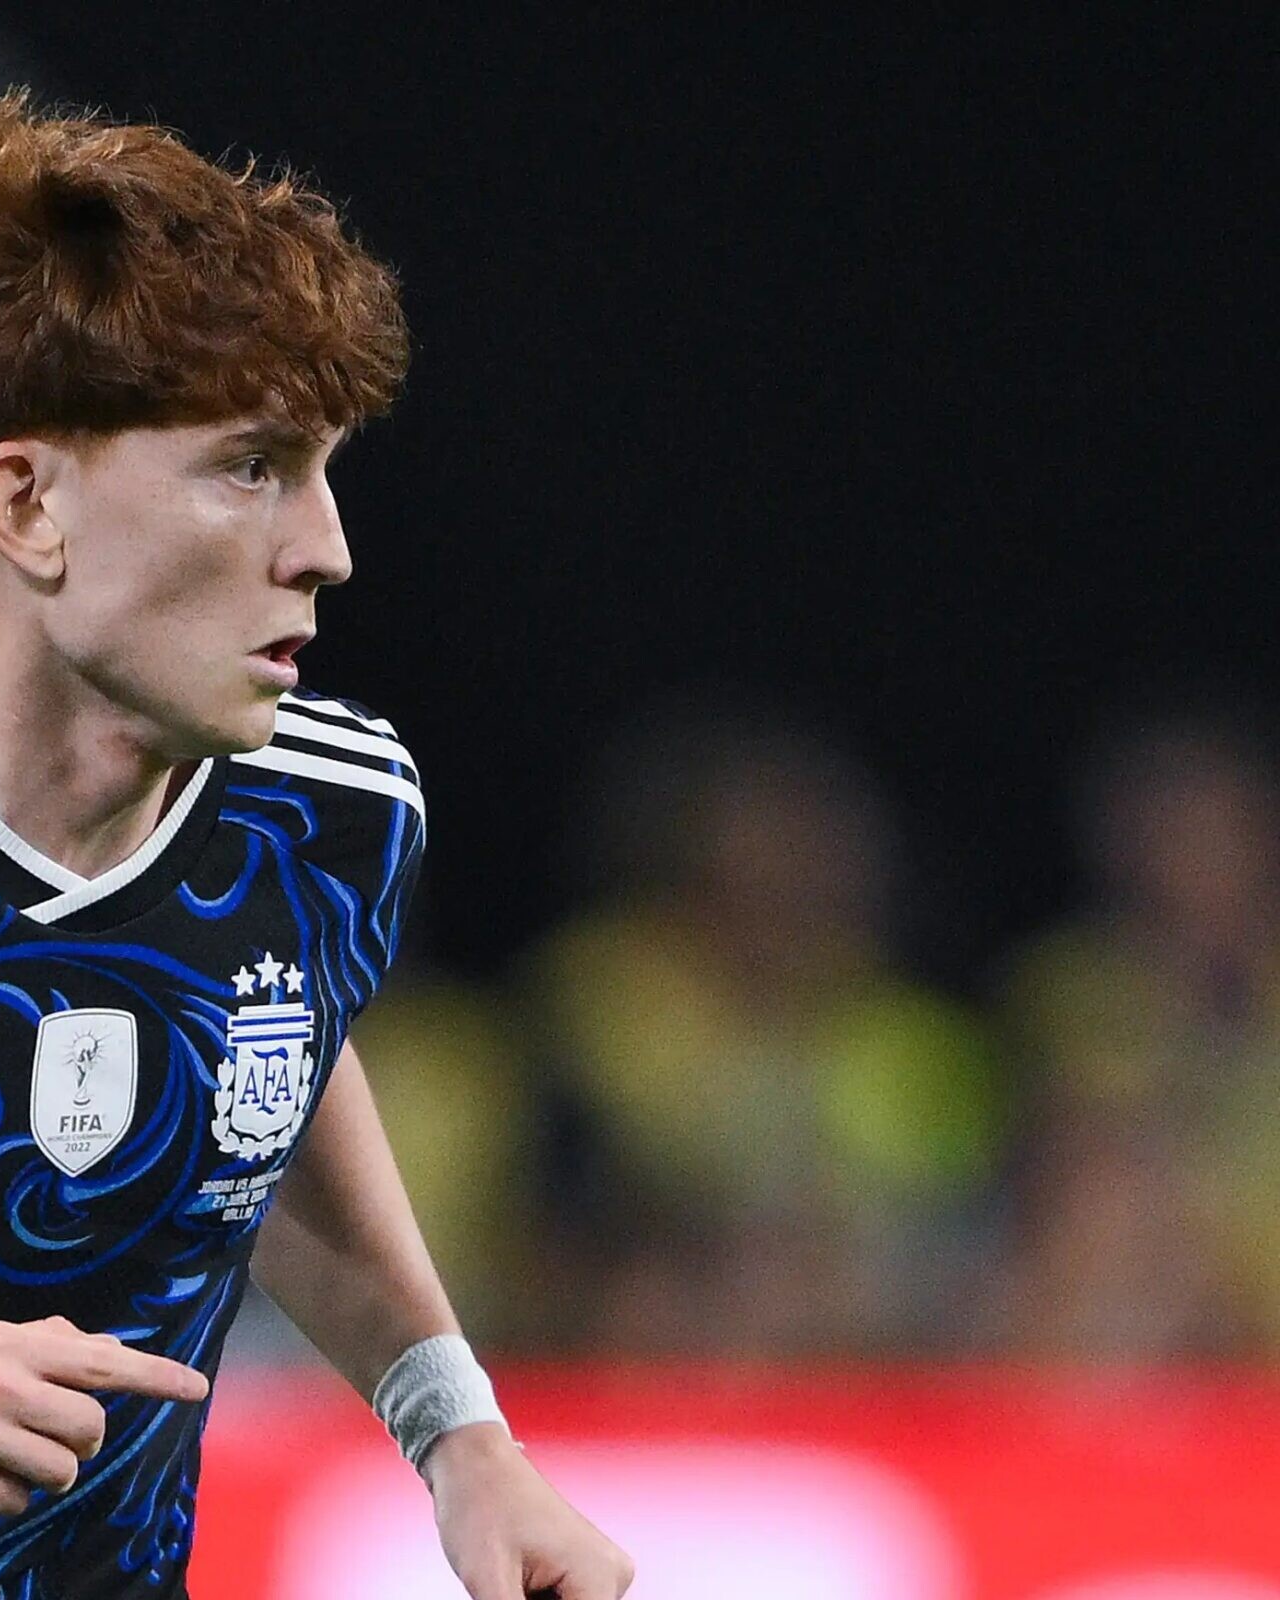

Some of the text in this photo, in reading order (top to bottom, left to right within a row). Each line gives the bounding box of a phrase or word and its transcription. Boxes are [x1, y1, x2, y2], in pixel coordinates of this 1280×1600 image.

[239, 1046, 293, 1116] AFA
[60, 1114, 102, 1133] FIFA
[64, 1142, 91, 1153] 2022
[212, 1194, 226, 1208] 27
